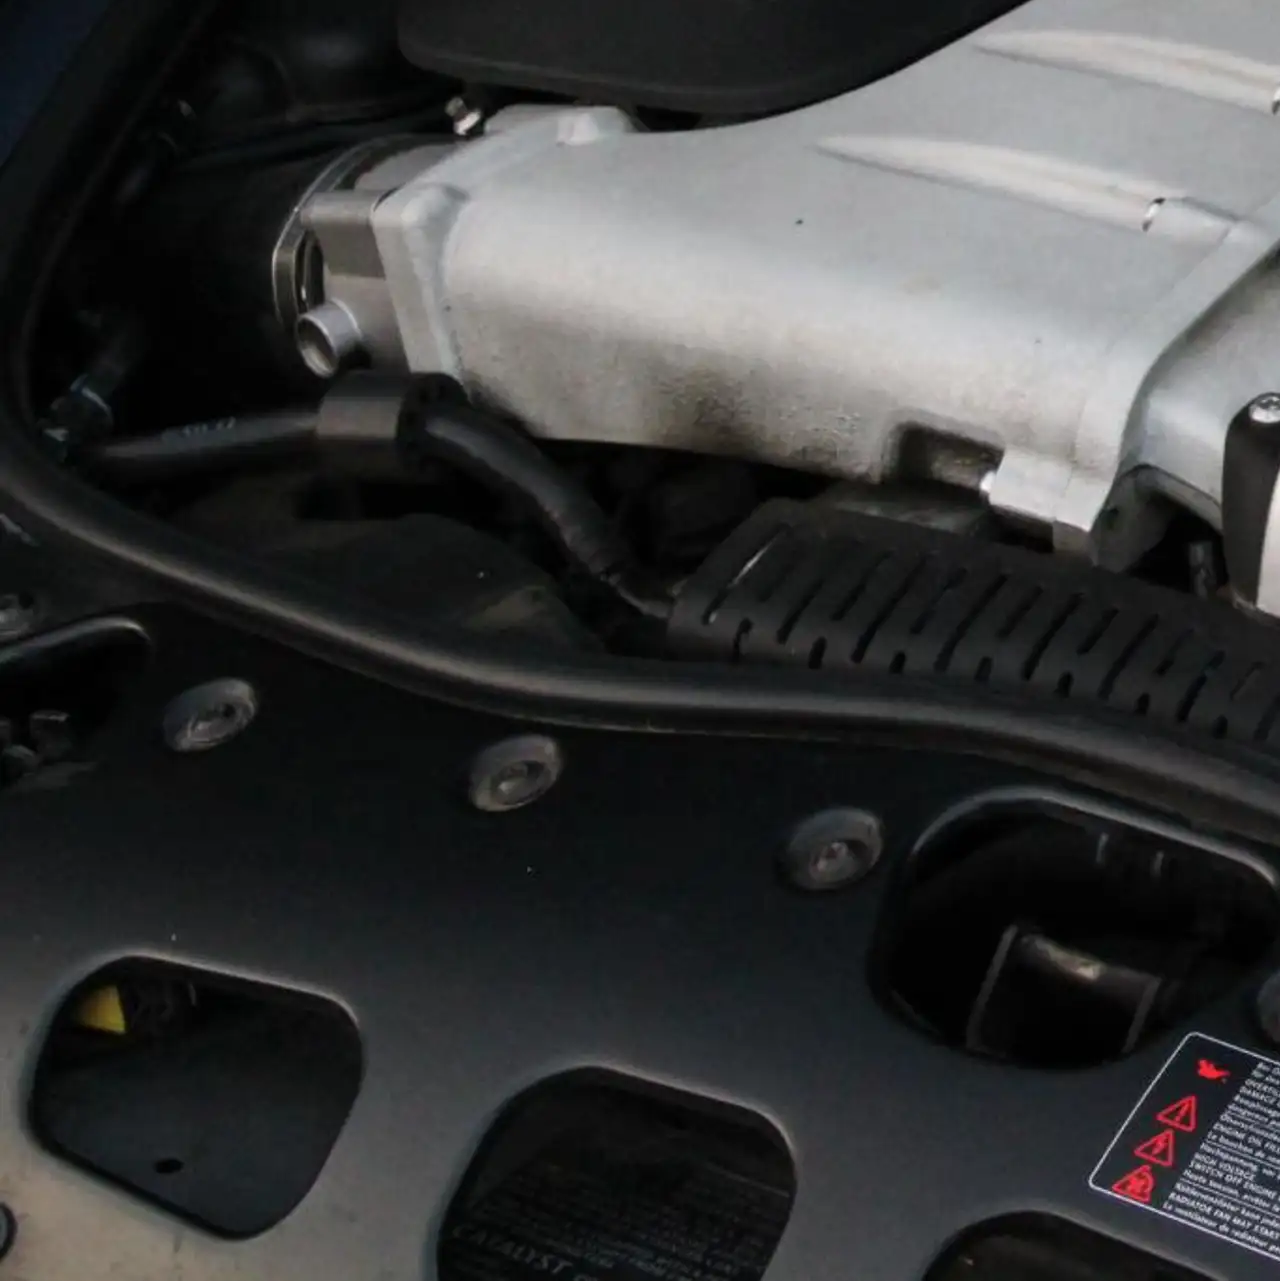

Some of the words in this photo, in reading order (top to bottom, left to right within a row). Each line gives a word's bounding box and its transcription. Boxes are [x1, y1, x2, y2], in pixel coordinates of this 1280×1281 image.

[1217, 1161, 1255, 1179] VOLTAGE
[1223, 1174, 1242, 1185] OFF
[1242, 1181, 1276, 1198] ENGINE
[1167, 1192, 1212, 1213] RADIATOR
[1212, 1209, 1231, 1221] FAN
[1231, 1217, 1252, 1228] MAY
[1252, 1225, 1280, 1240] START
